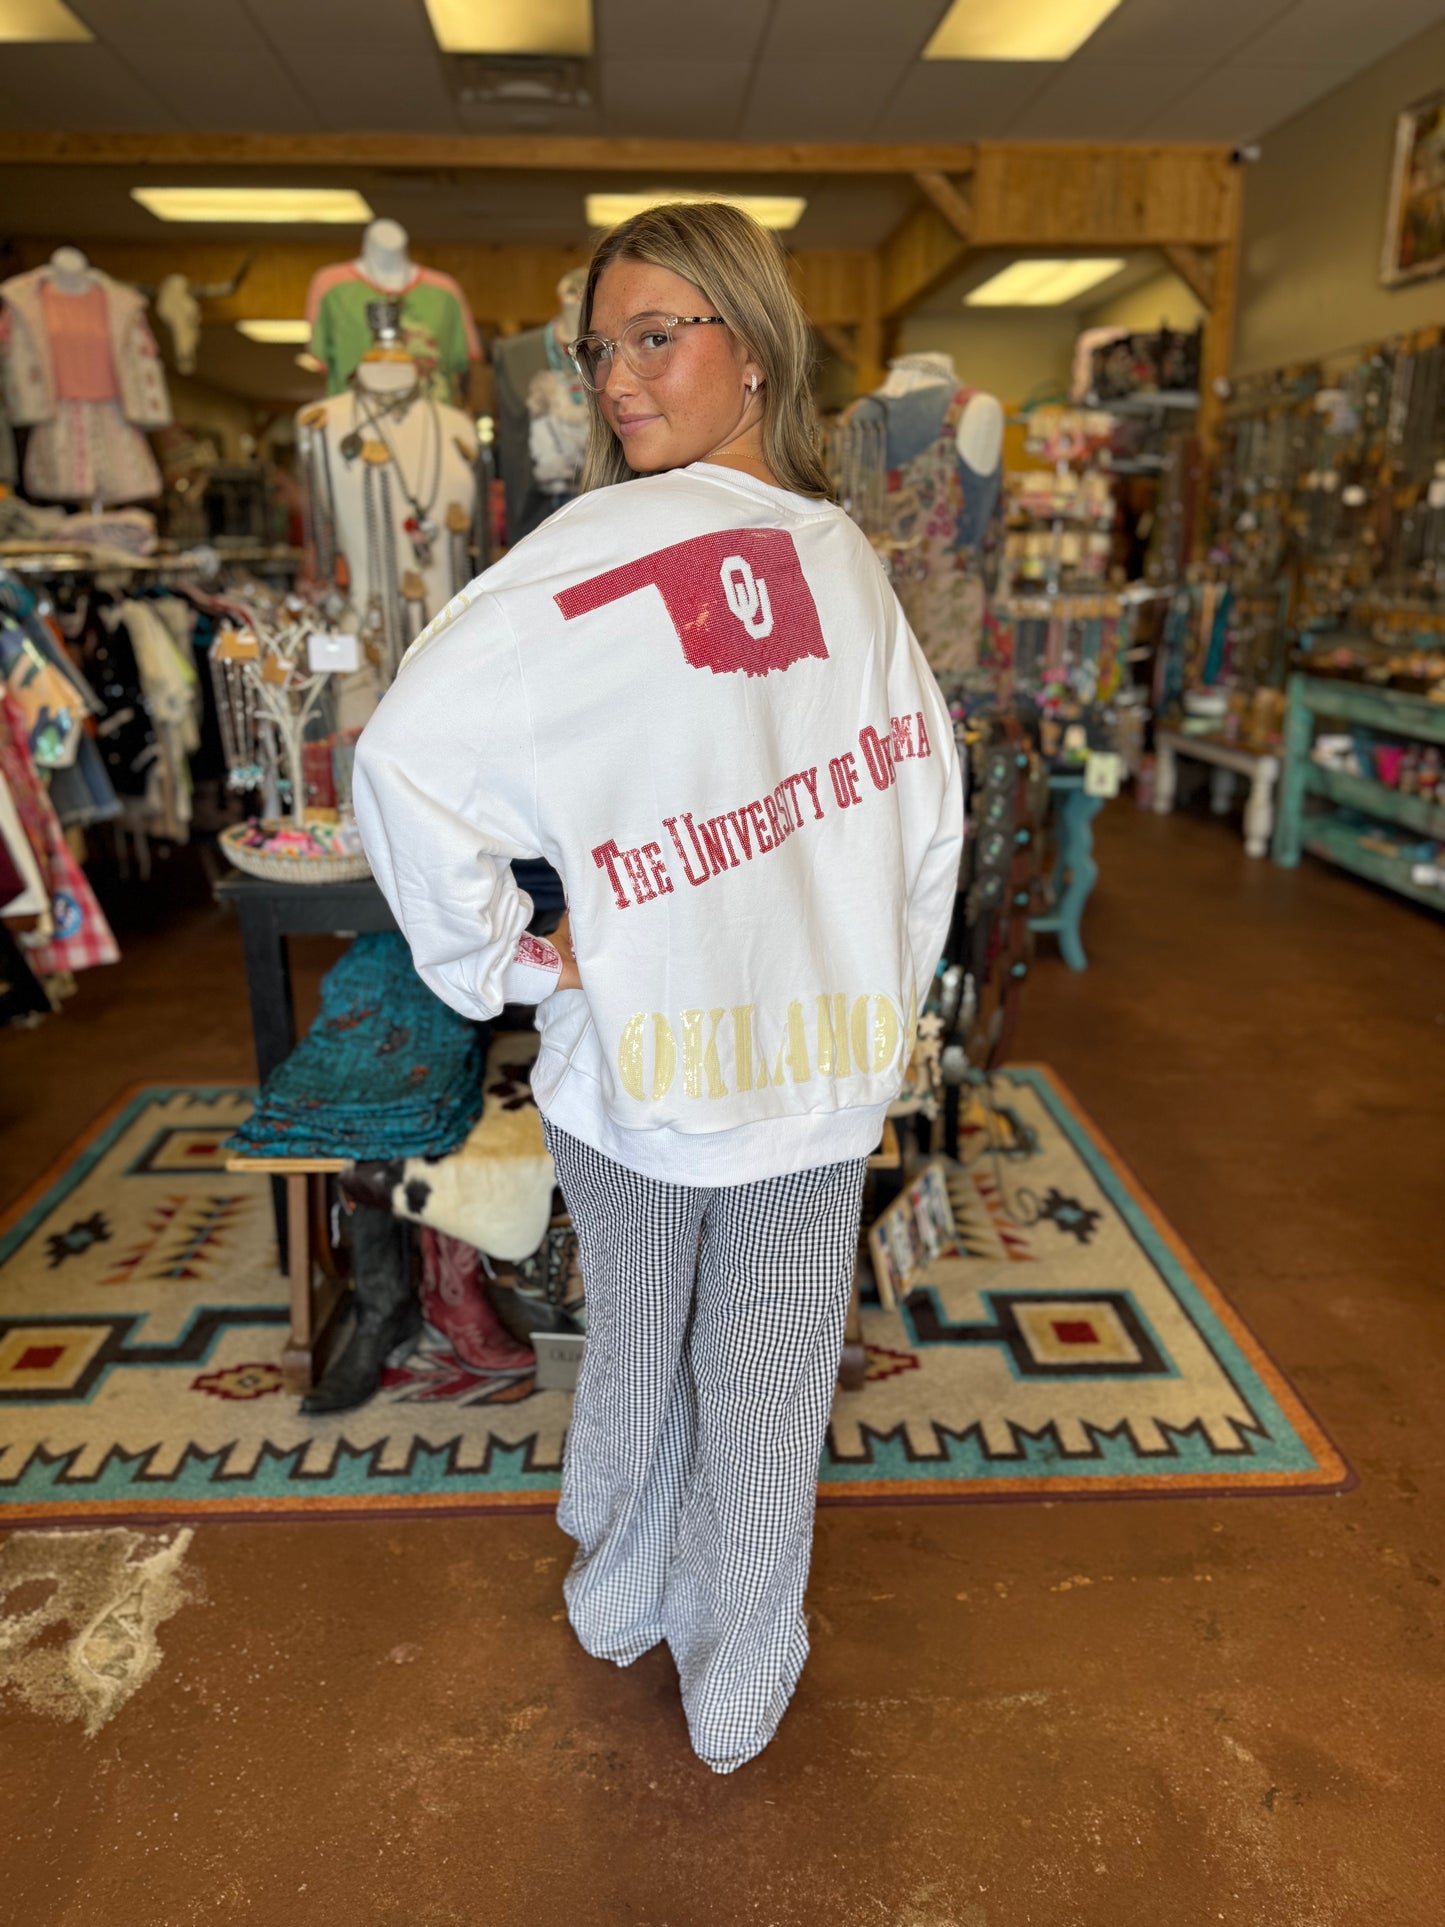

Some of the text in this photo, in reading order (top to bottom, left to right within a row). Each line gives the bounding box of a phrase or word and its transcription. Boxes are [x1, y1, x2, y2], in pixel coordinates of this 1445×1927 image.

[719, 554, 775, 640] OU
[591, 838, 675, 910] THE
[661, 766, 825, 887] UNIVERSITY
[828, 751, 863, 809] OF
